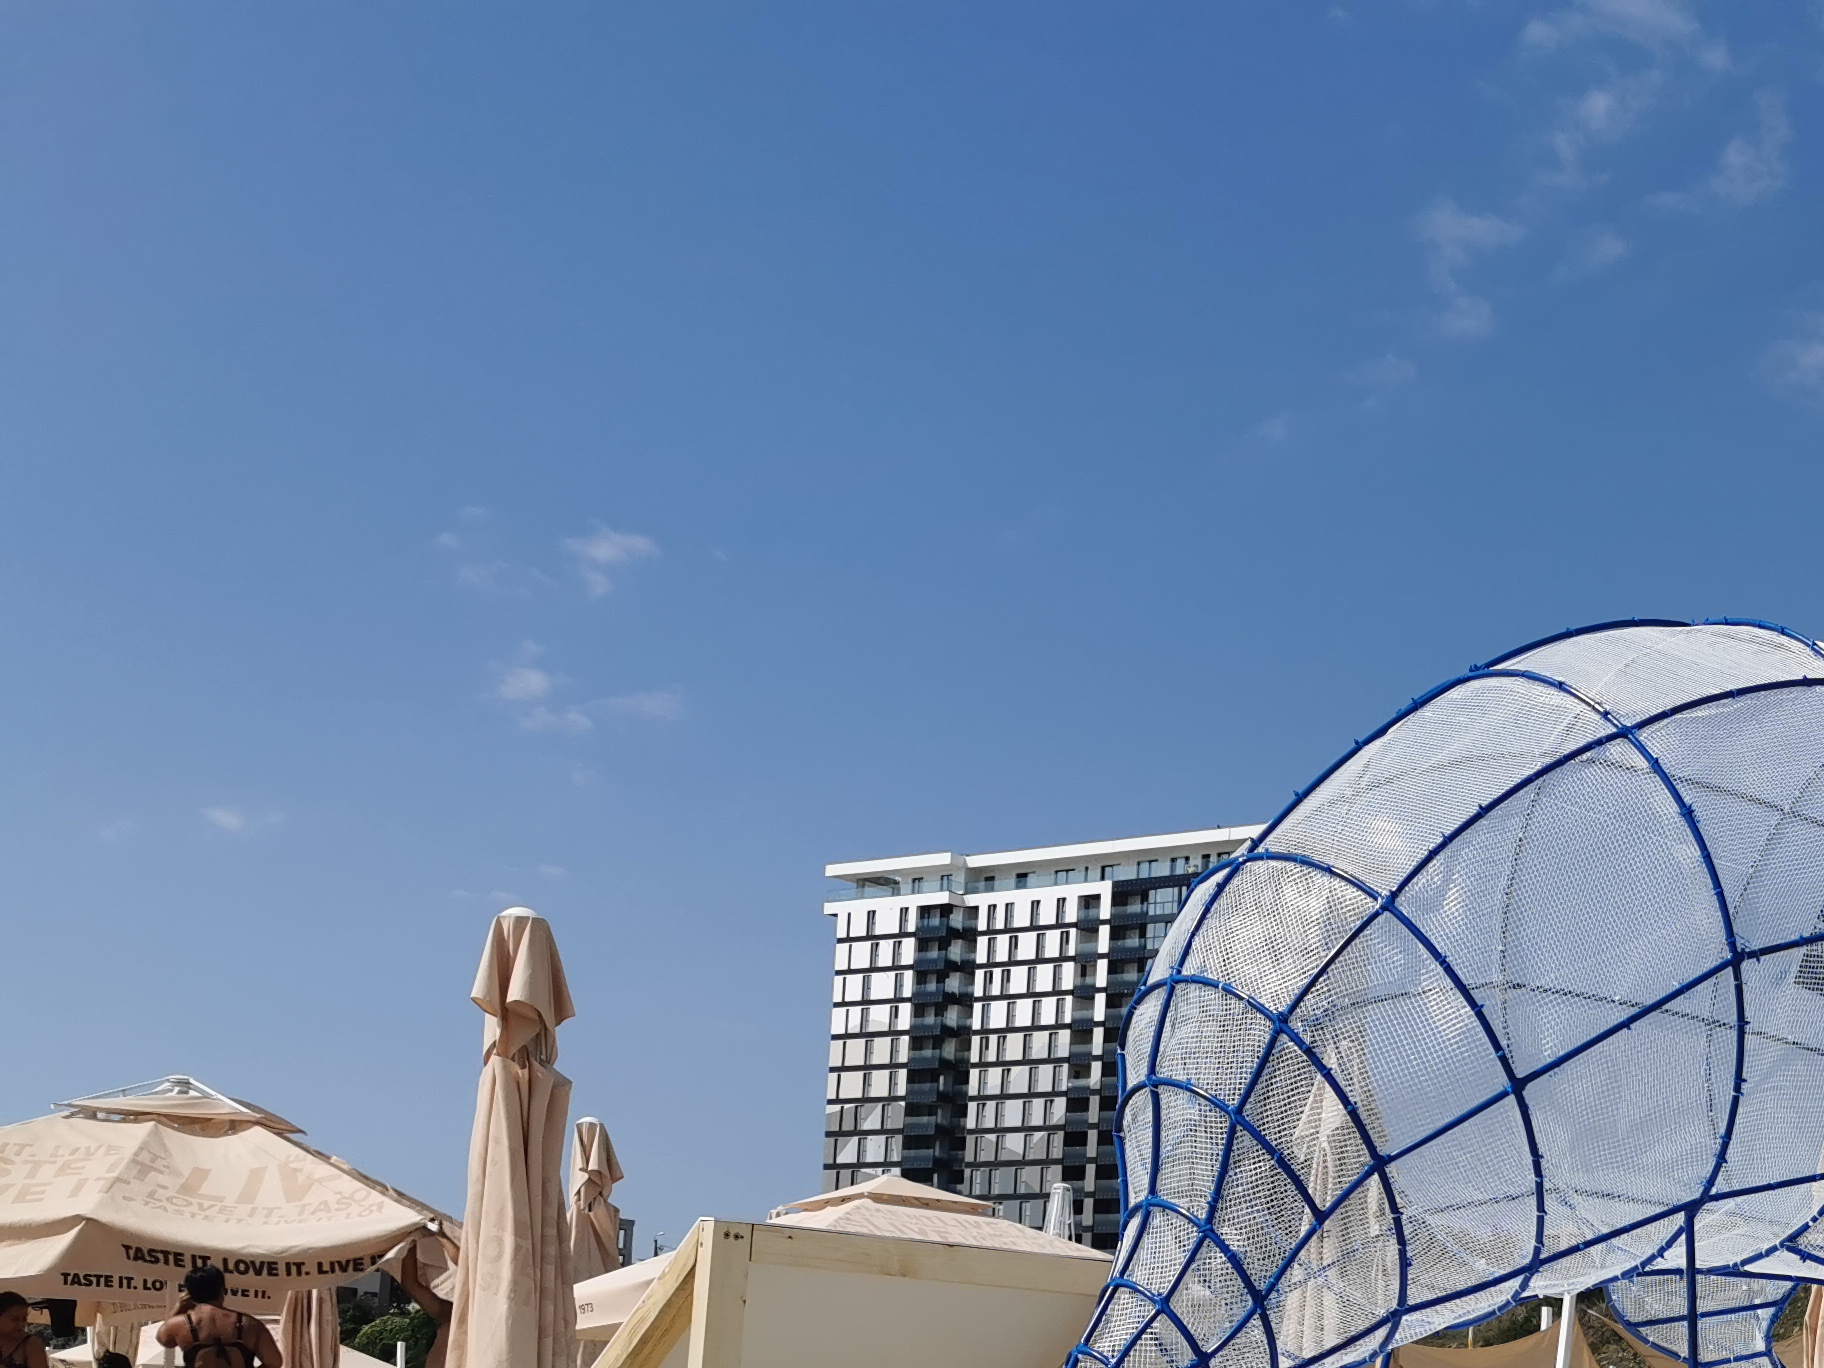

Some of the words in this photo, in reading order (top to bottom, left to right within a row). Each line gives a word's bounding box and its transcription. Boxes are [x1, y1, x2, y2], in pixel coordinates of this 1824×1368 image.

[121, 1244, 185, 1269] TASTE
[222, 1257, 279, 1277] LOVE
[285, 1261, 311, 1277] IT.
[317, 1255, 366, 1275] LIVE
[61, 1272, 114, 1289] TASTE
[118, 1276, 138, 1290] IT.
[578, 1303, 594, 1315] 1973
